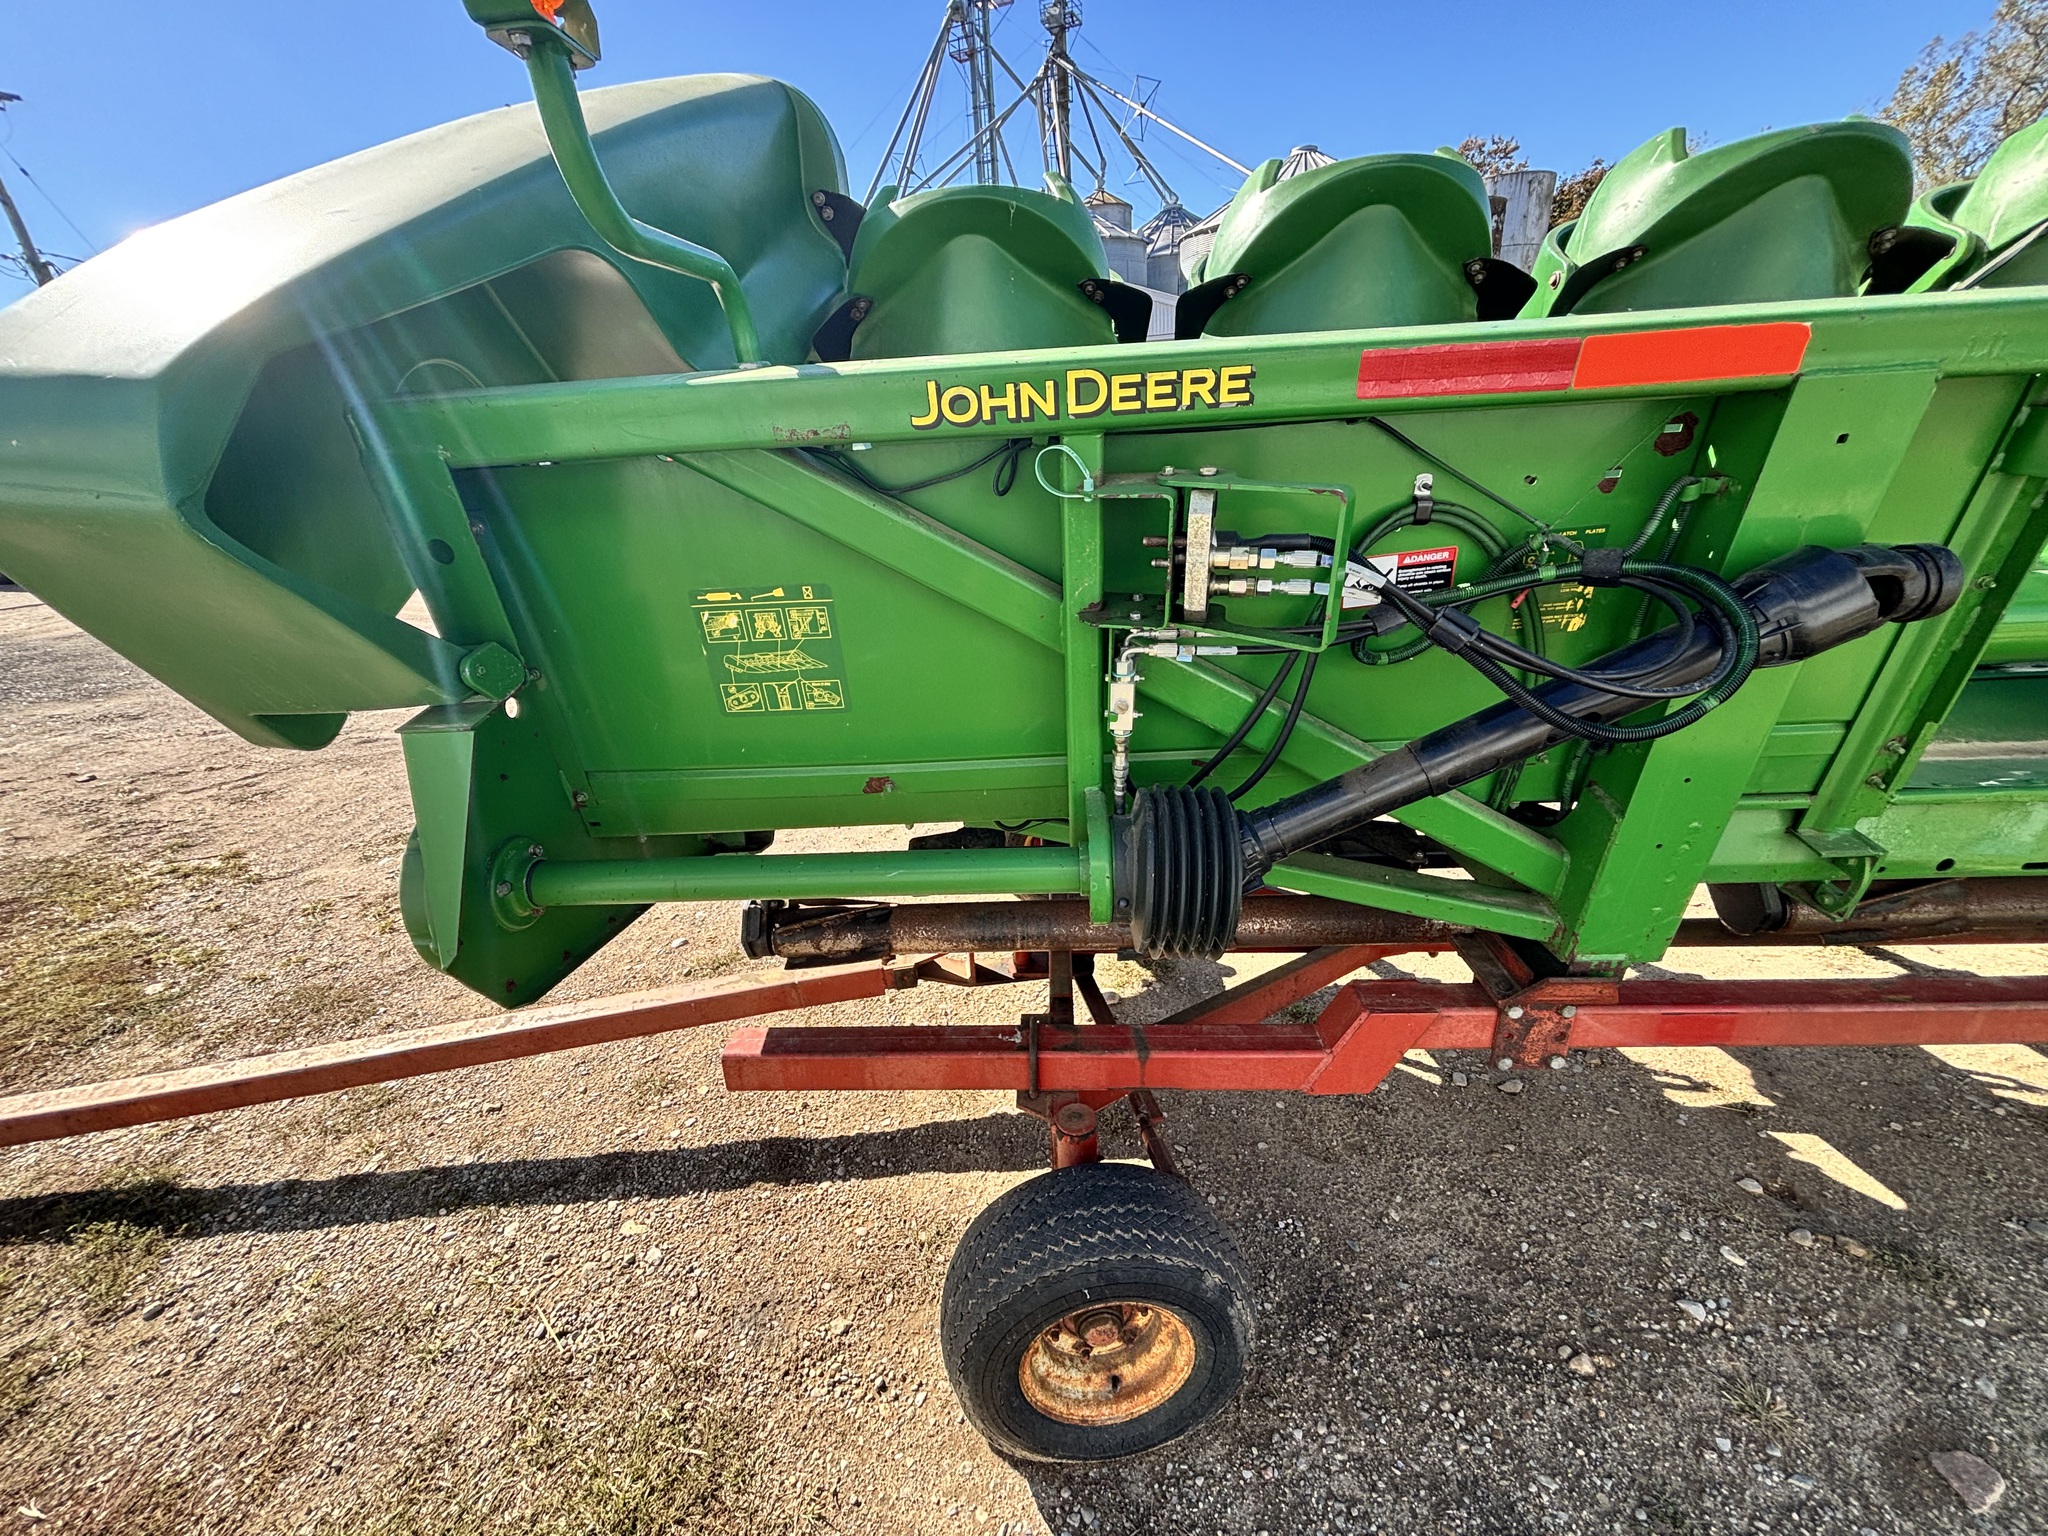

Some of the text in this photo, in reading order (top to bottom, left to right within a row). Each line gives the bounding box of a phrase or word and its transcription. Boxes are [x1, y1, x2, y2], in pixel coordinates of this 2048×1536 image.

[910, 364, 1256, 431] JOHN DEERE
[1585, 527, 1606, 535] PLATES
[1410, 551, 1450, 563] DANGER
